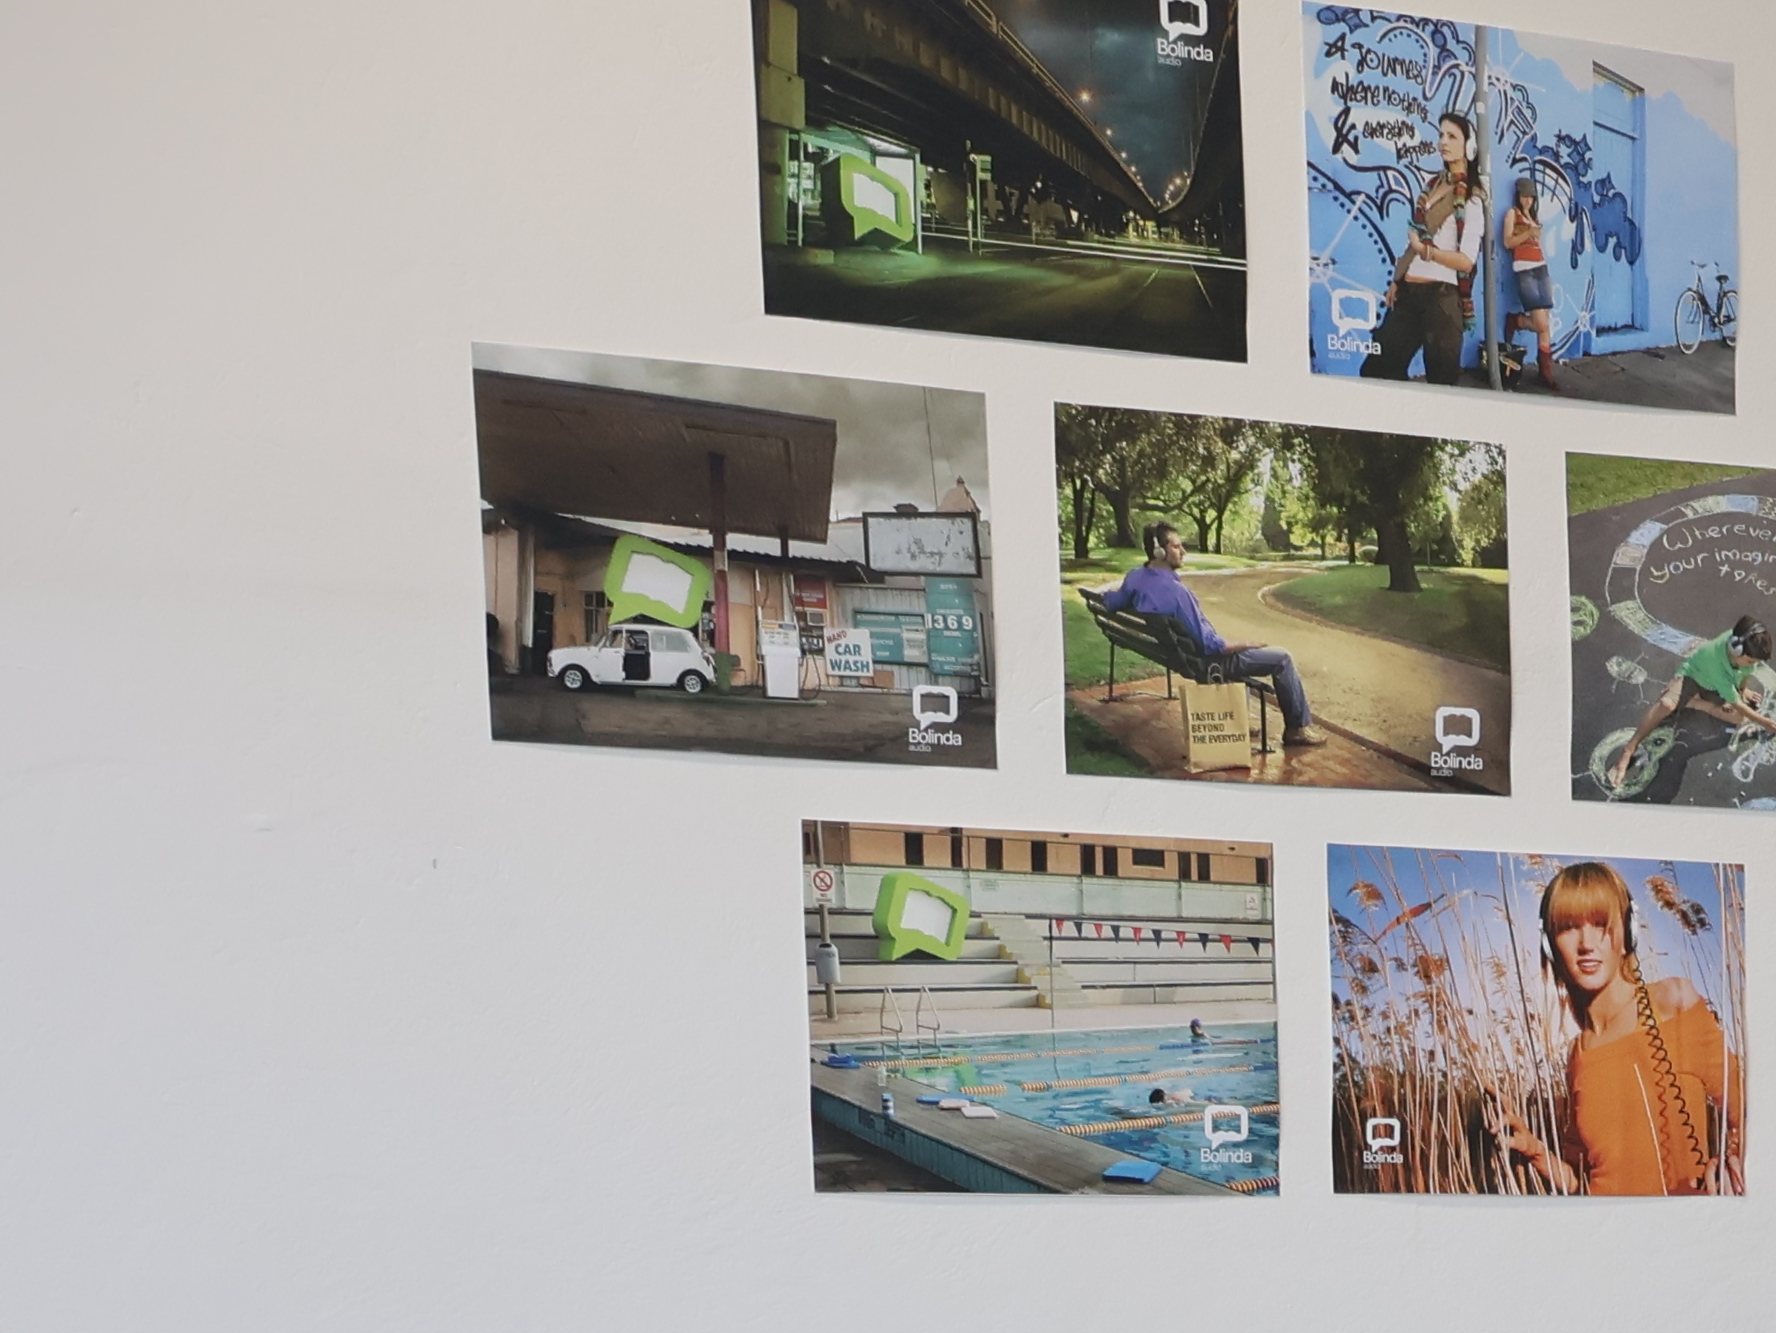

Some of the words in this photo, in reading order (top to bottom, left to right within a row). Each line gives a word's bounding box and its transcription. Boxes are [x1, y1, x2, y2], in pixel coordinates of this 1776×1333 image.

[1157, 37, 1214, 62] Bolinda
[1332, 105, 1360, 155] &
[1327, 333, 1382, 356] Bolinda
[1649, 552, 1710, 584] your
[834, 643, 862, 657] CAR
[829, 659, 871, 674] WASH
[1191, 711, 1216, 721] TASTE
[1218, 711, 1234, 721] LIFE
[1191, 723, 1225, 733] BEYOND
[908, 727, 963, 746] Bolinda
[1192, 734, 1207, 744] THE
[1431, 751, 1483, 770] Bolinda
[1200, 1147, 1252, 1163] Bolinda
[1363, 1150, 1404, 1164] Bolinda
